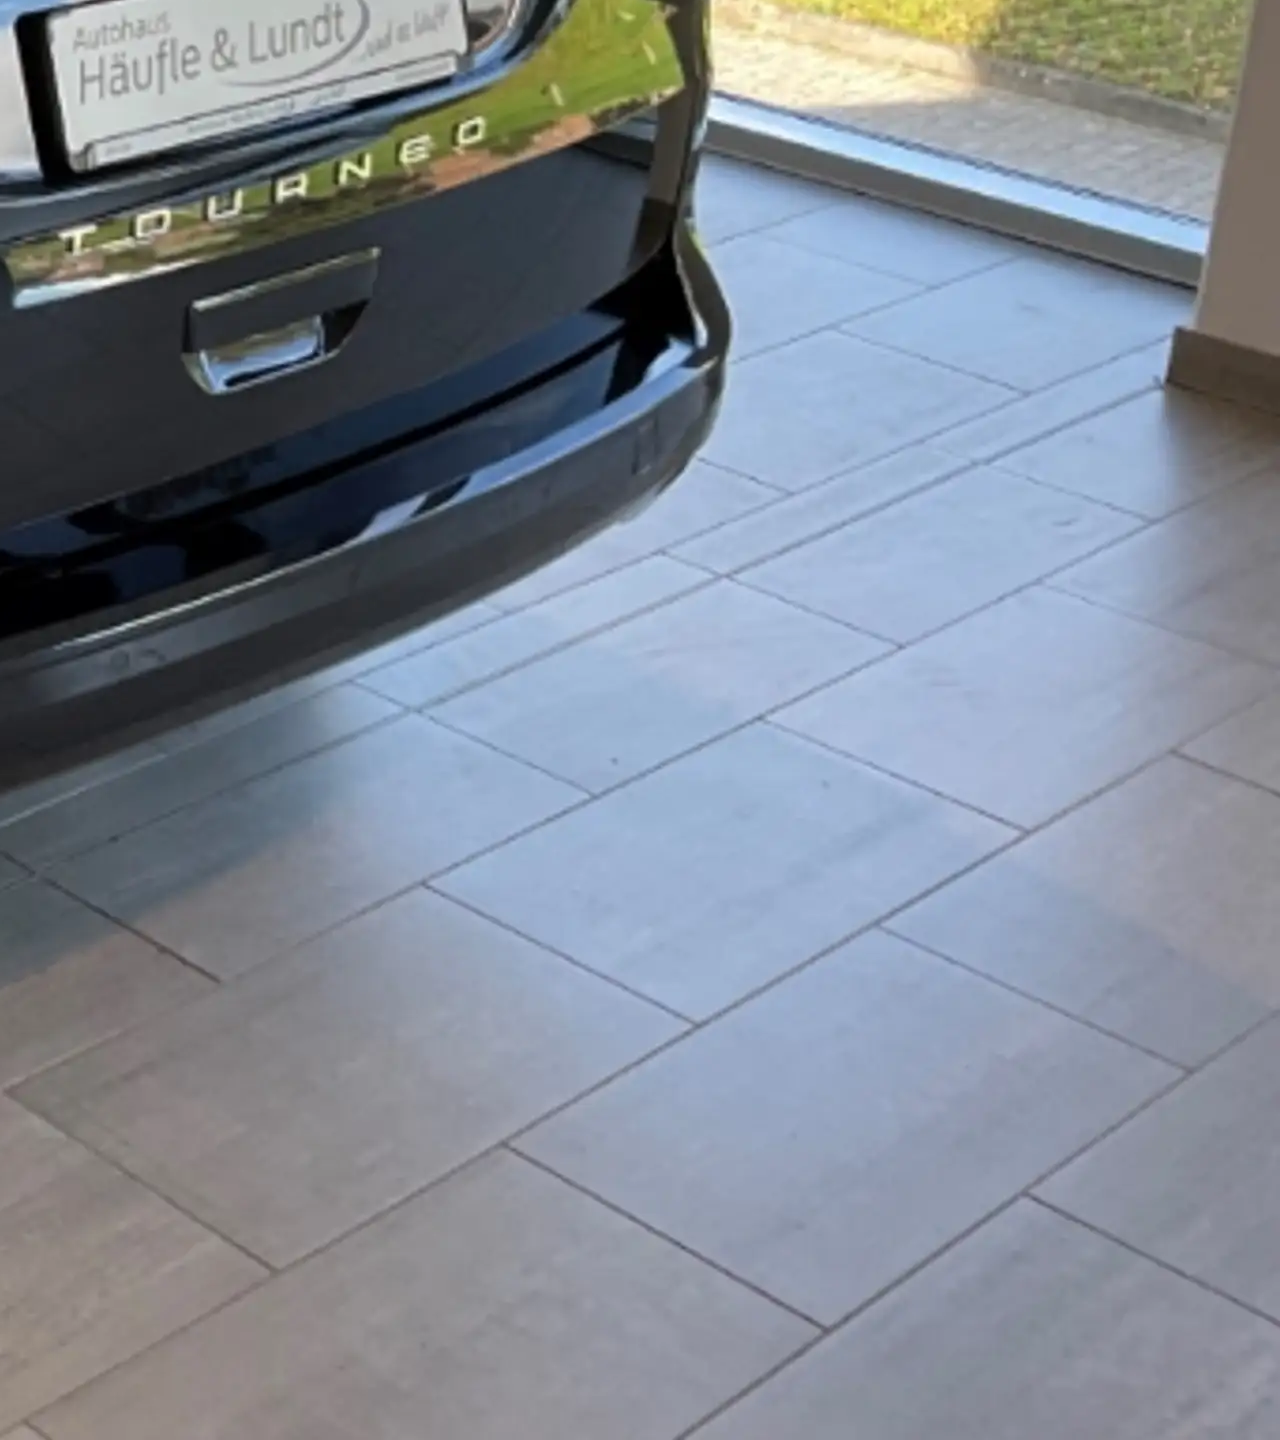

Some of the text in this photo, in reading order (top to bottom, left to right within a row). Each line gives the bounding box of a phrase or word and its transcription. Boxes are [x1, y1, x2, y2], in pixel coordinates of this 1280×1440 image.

[78, 35, 203, 107] Häufle
[210, 26, 239, 73] &
[248, 1, 346, 64] Lundt
[56, 115, 488, 258] TOURNEO
